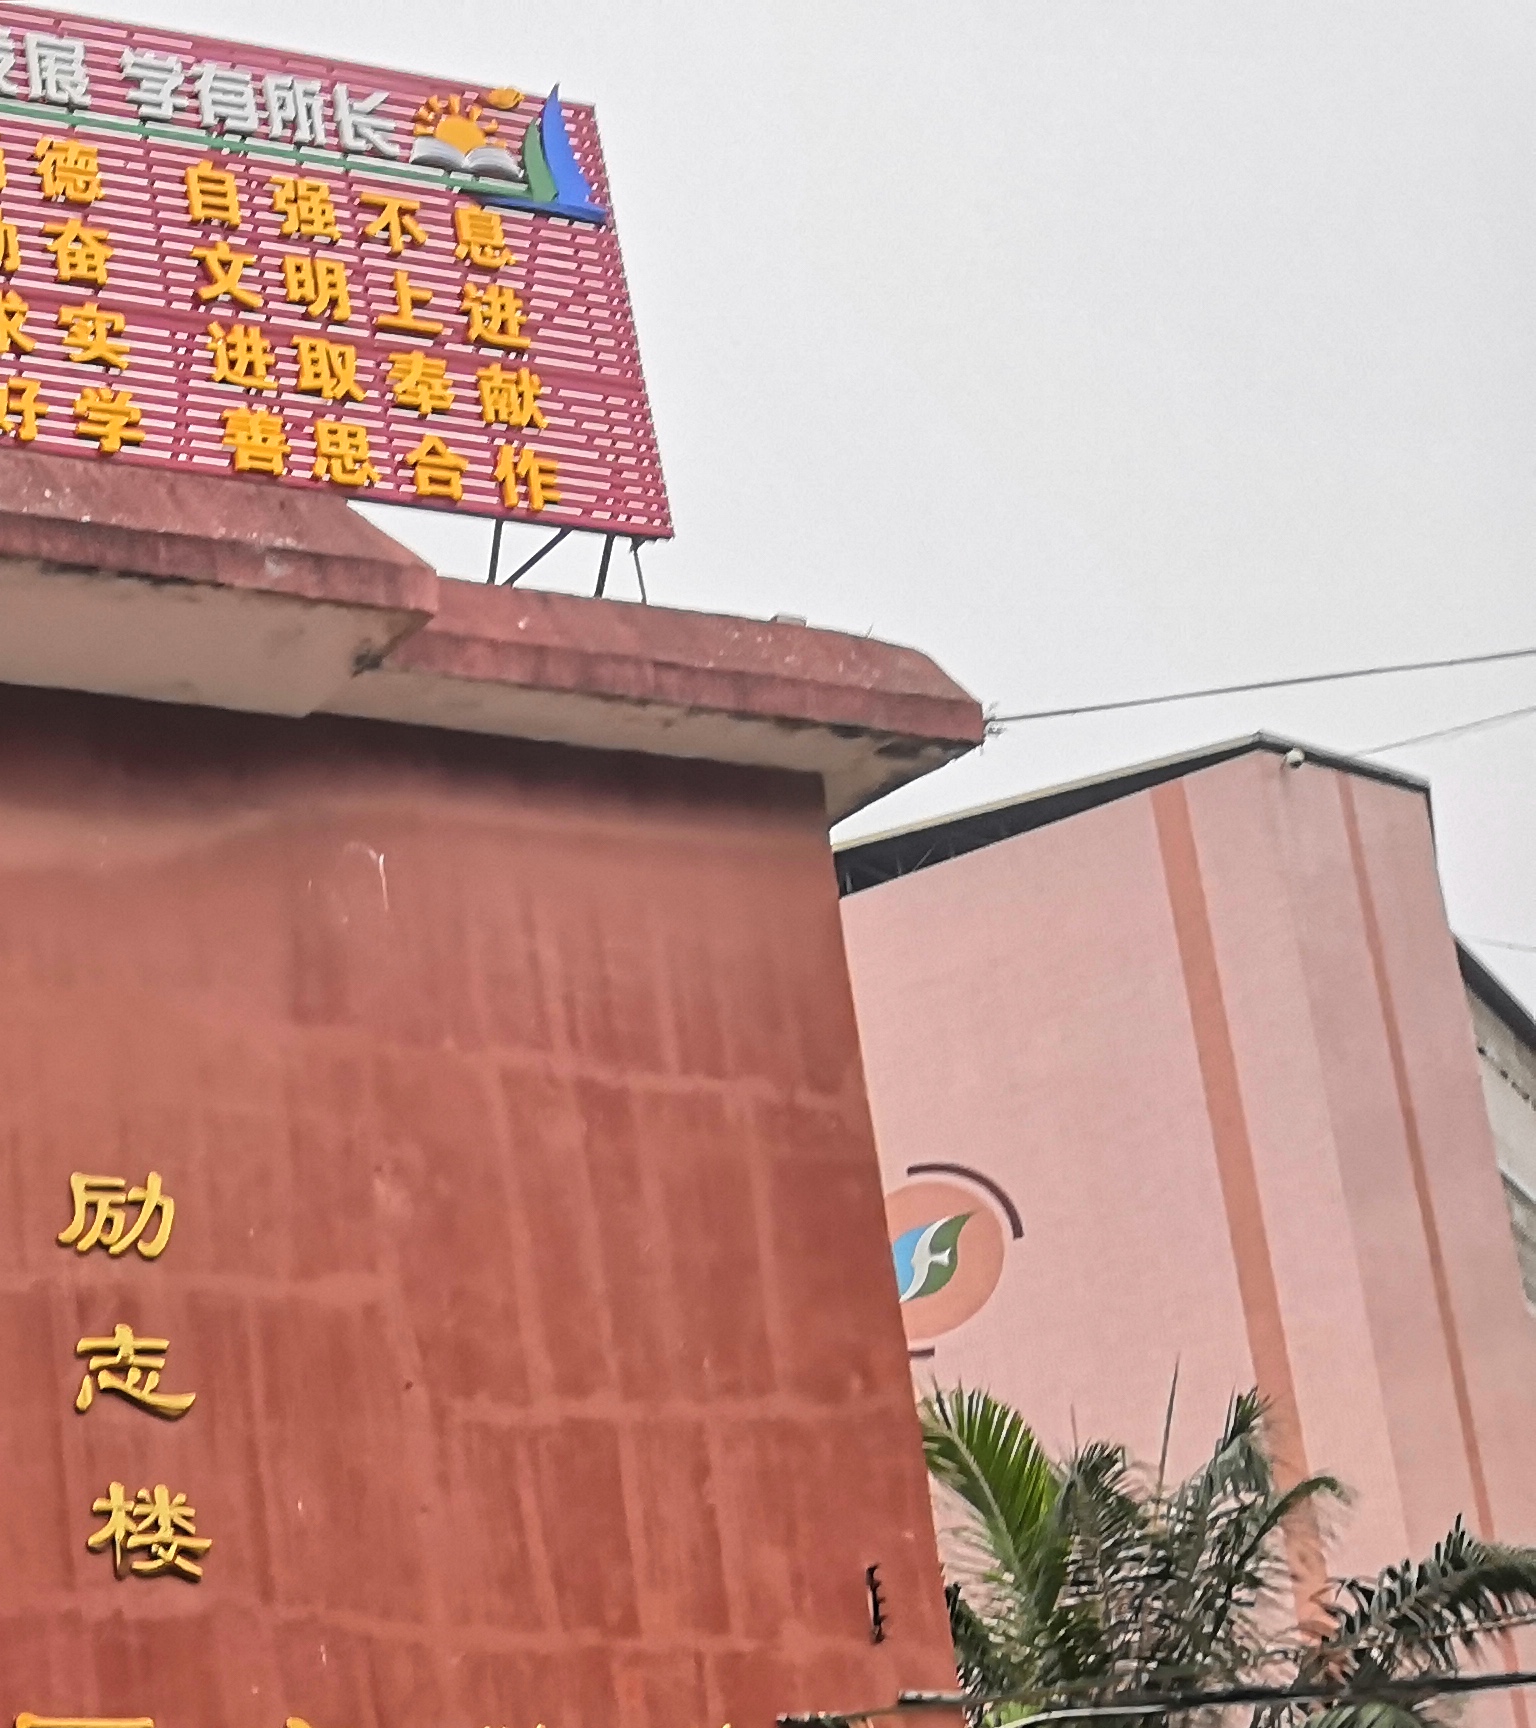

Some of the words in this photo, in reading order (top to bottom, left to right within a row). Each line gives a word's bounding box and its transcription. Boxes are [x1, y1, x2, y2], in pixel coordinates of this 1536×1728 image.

[118, 47, 400, 157] 学有所长
[183, 160, 516, 269] 自强不息
[191, 242, 531, 351] 文明上进
[207, 322, 550, 430] 进取奉献
[222, 405, 561, 513] 善思合作
[57, 1170, 214, 1583] 励志楼
